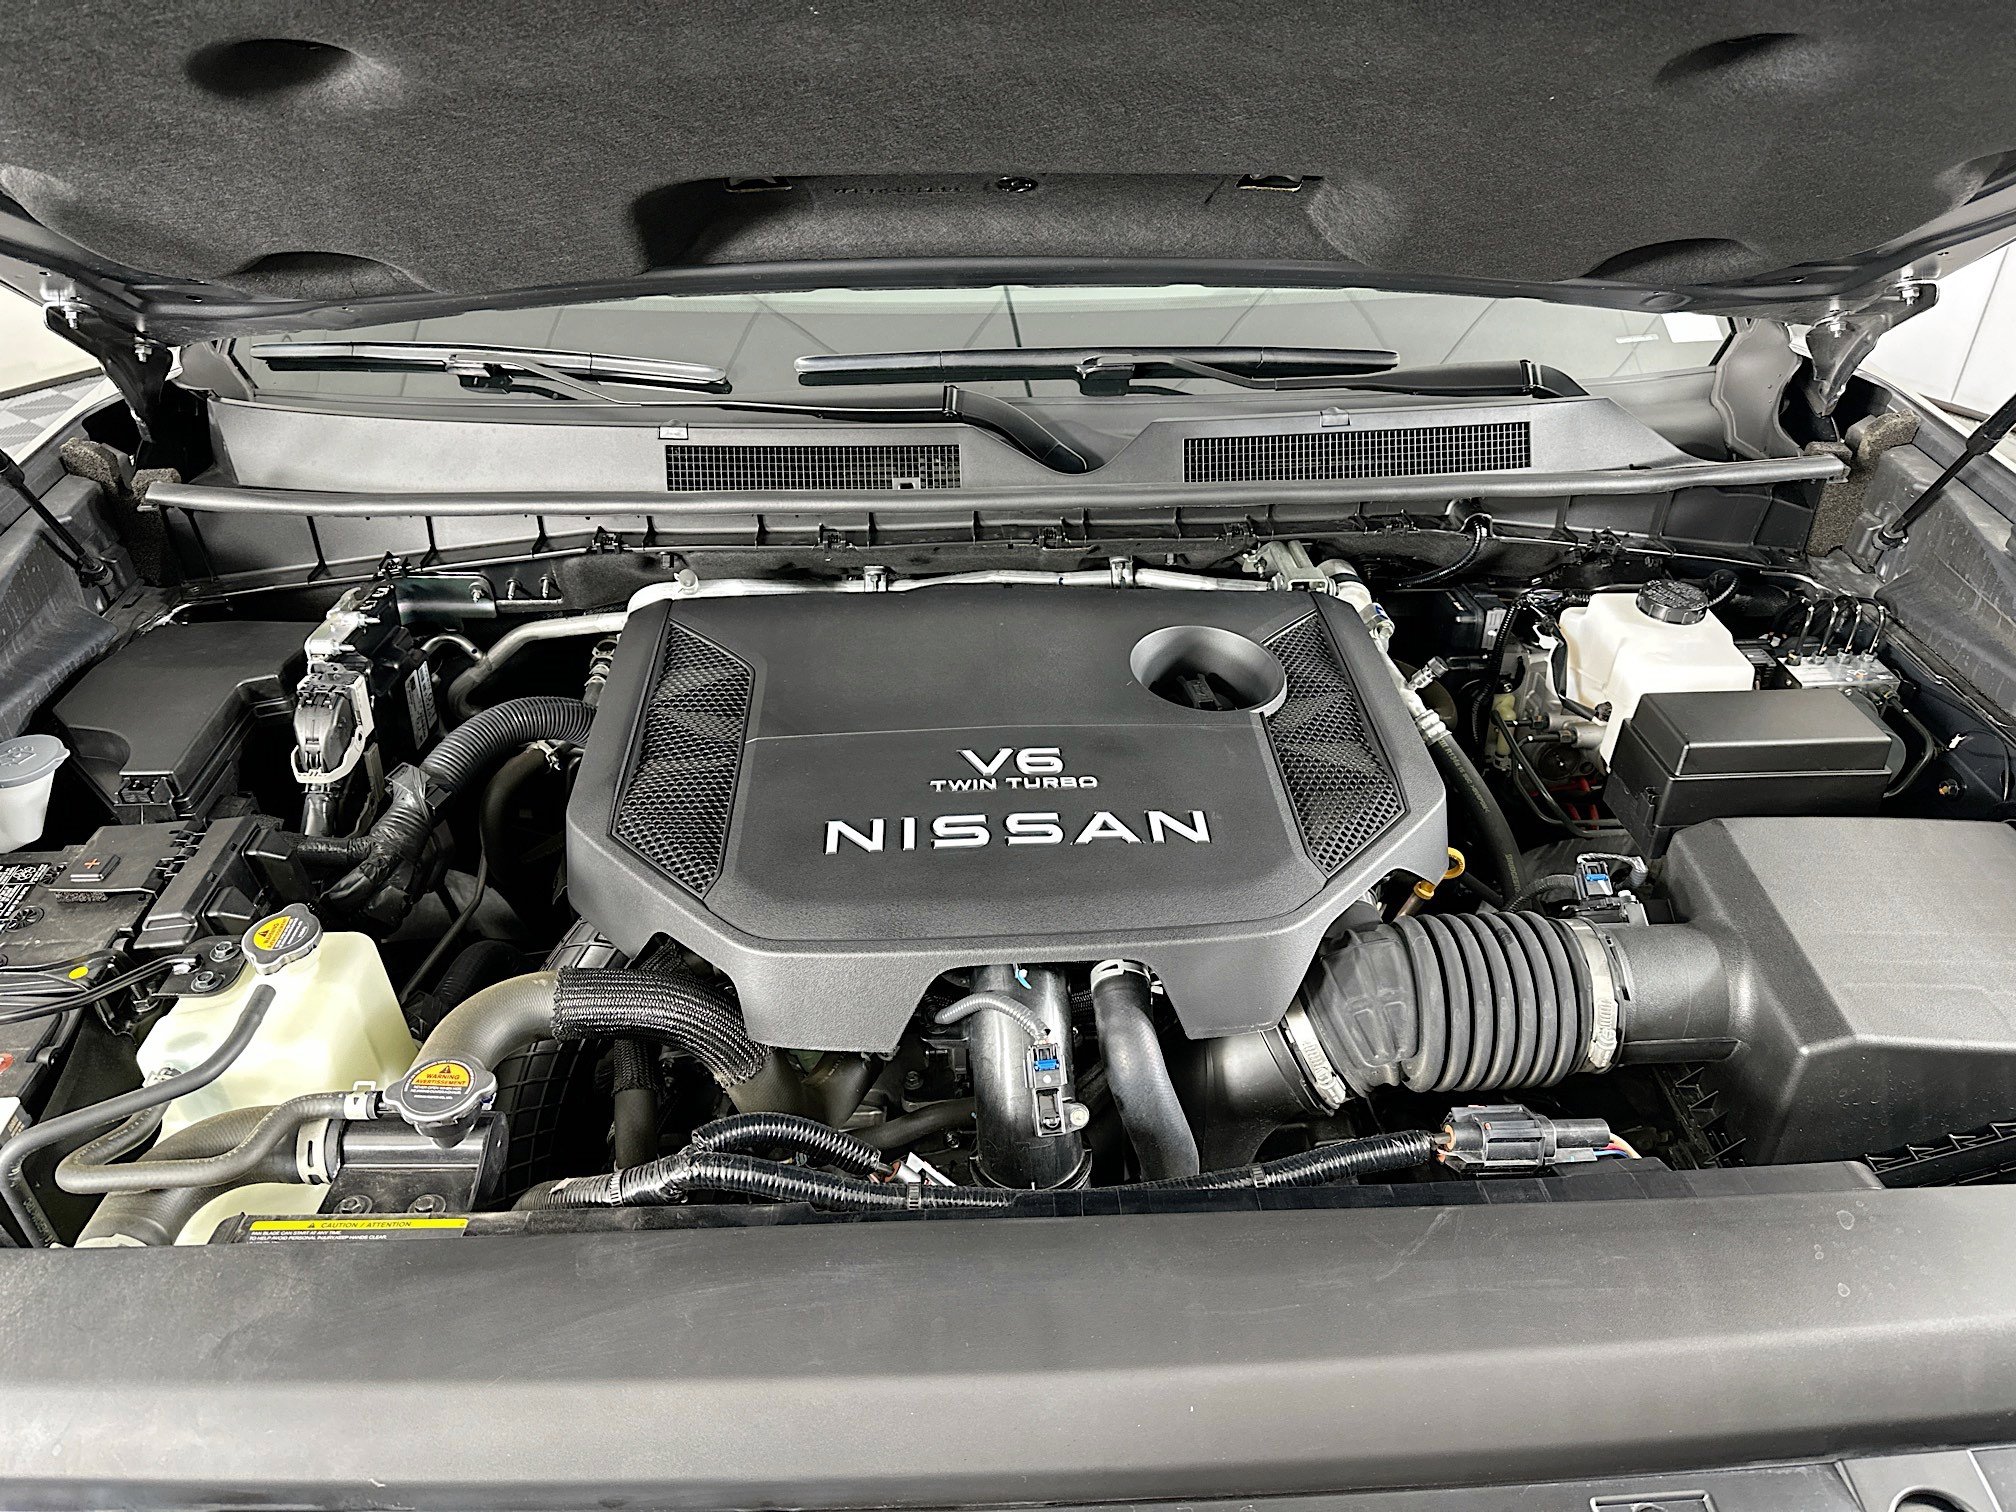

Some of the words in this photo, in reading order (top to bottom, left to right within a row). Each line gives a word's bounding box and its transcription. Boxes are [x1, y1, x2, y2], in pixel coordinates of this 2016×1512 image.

[957, 747, 1065, 776] V6
[930, 778, 998, 793] TWIN
[1005, 775, 1099, 791] TURBO
[822, 810, 1212, 856] NISSAN
